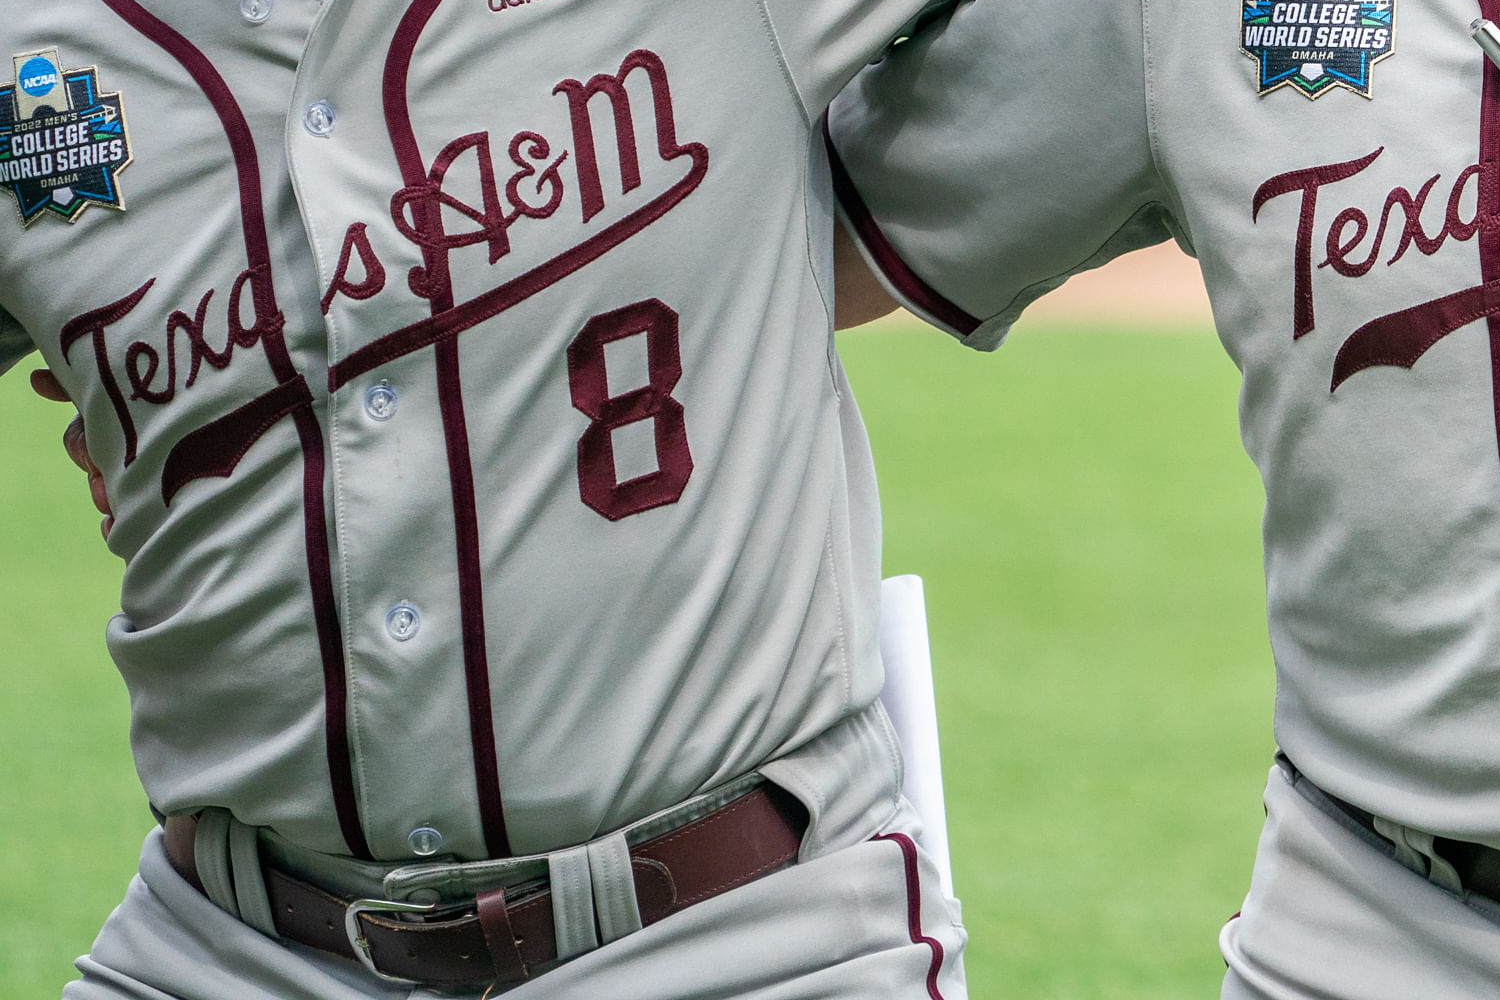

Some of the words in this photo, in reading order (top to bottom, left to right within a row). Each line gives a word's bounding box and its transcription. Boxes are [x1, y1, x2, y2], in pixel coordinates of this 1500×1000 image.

[1272, 2, 1360, 24] COLLEGE
[1244, 26, 1312, 47] WORLD
[1314, 27, 1389, 49] SERIES
[1291, 50, 1334, 60] OMAHA
[23, 73, 57, 90] NCAA
[14, 119, 42, 133] 2022
[44, 111, 78, 127] MEN'S
[11, 121, 90, 158] COLLEGE
[56, 138, 123, 173] SERIES
[40, 172, 80, 189] OMAHA
[390, 48, 709, 299] A&M
[566, 297, 694, 522] 8
